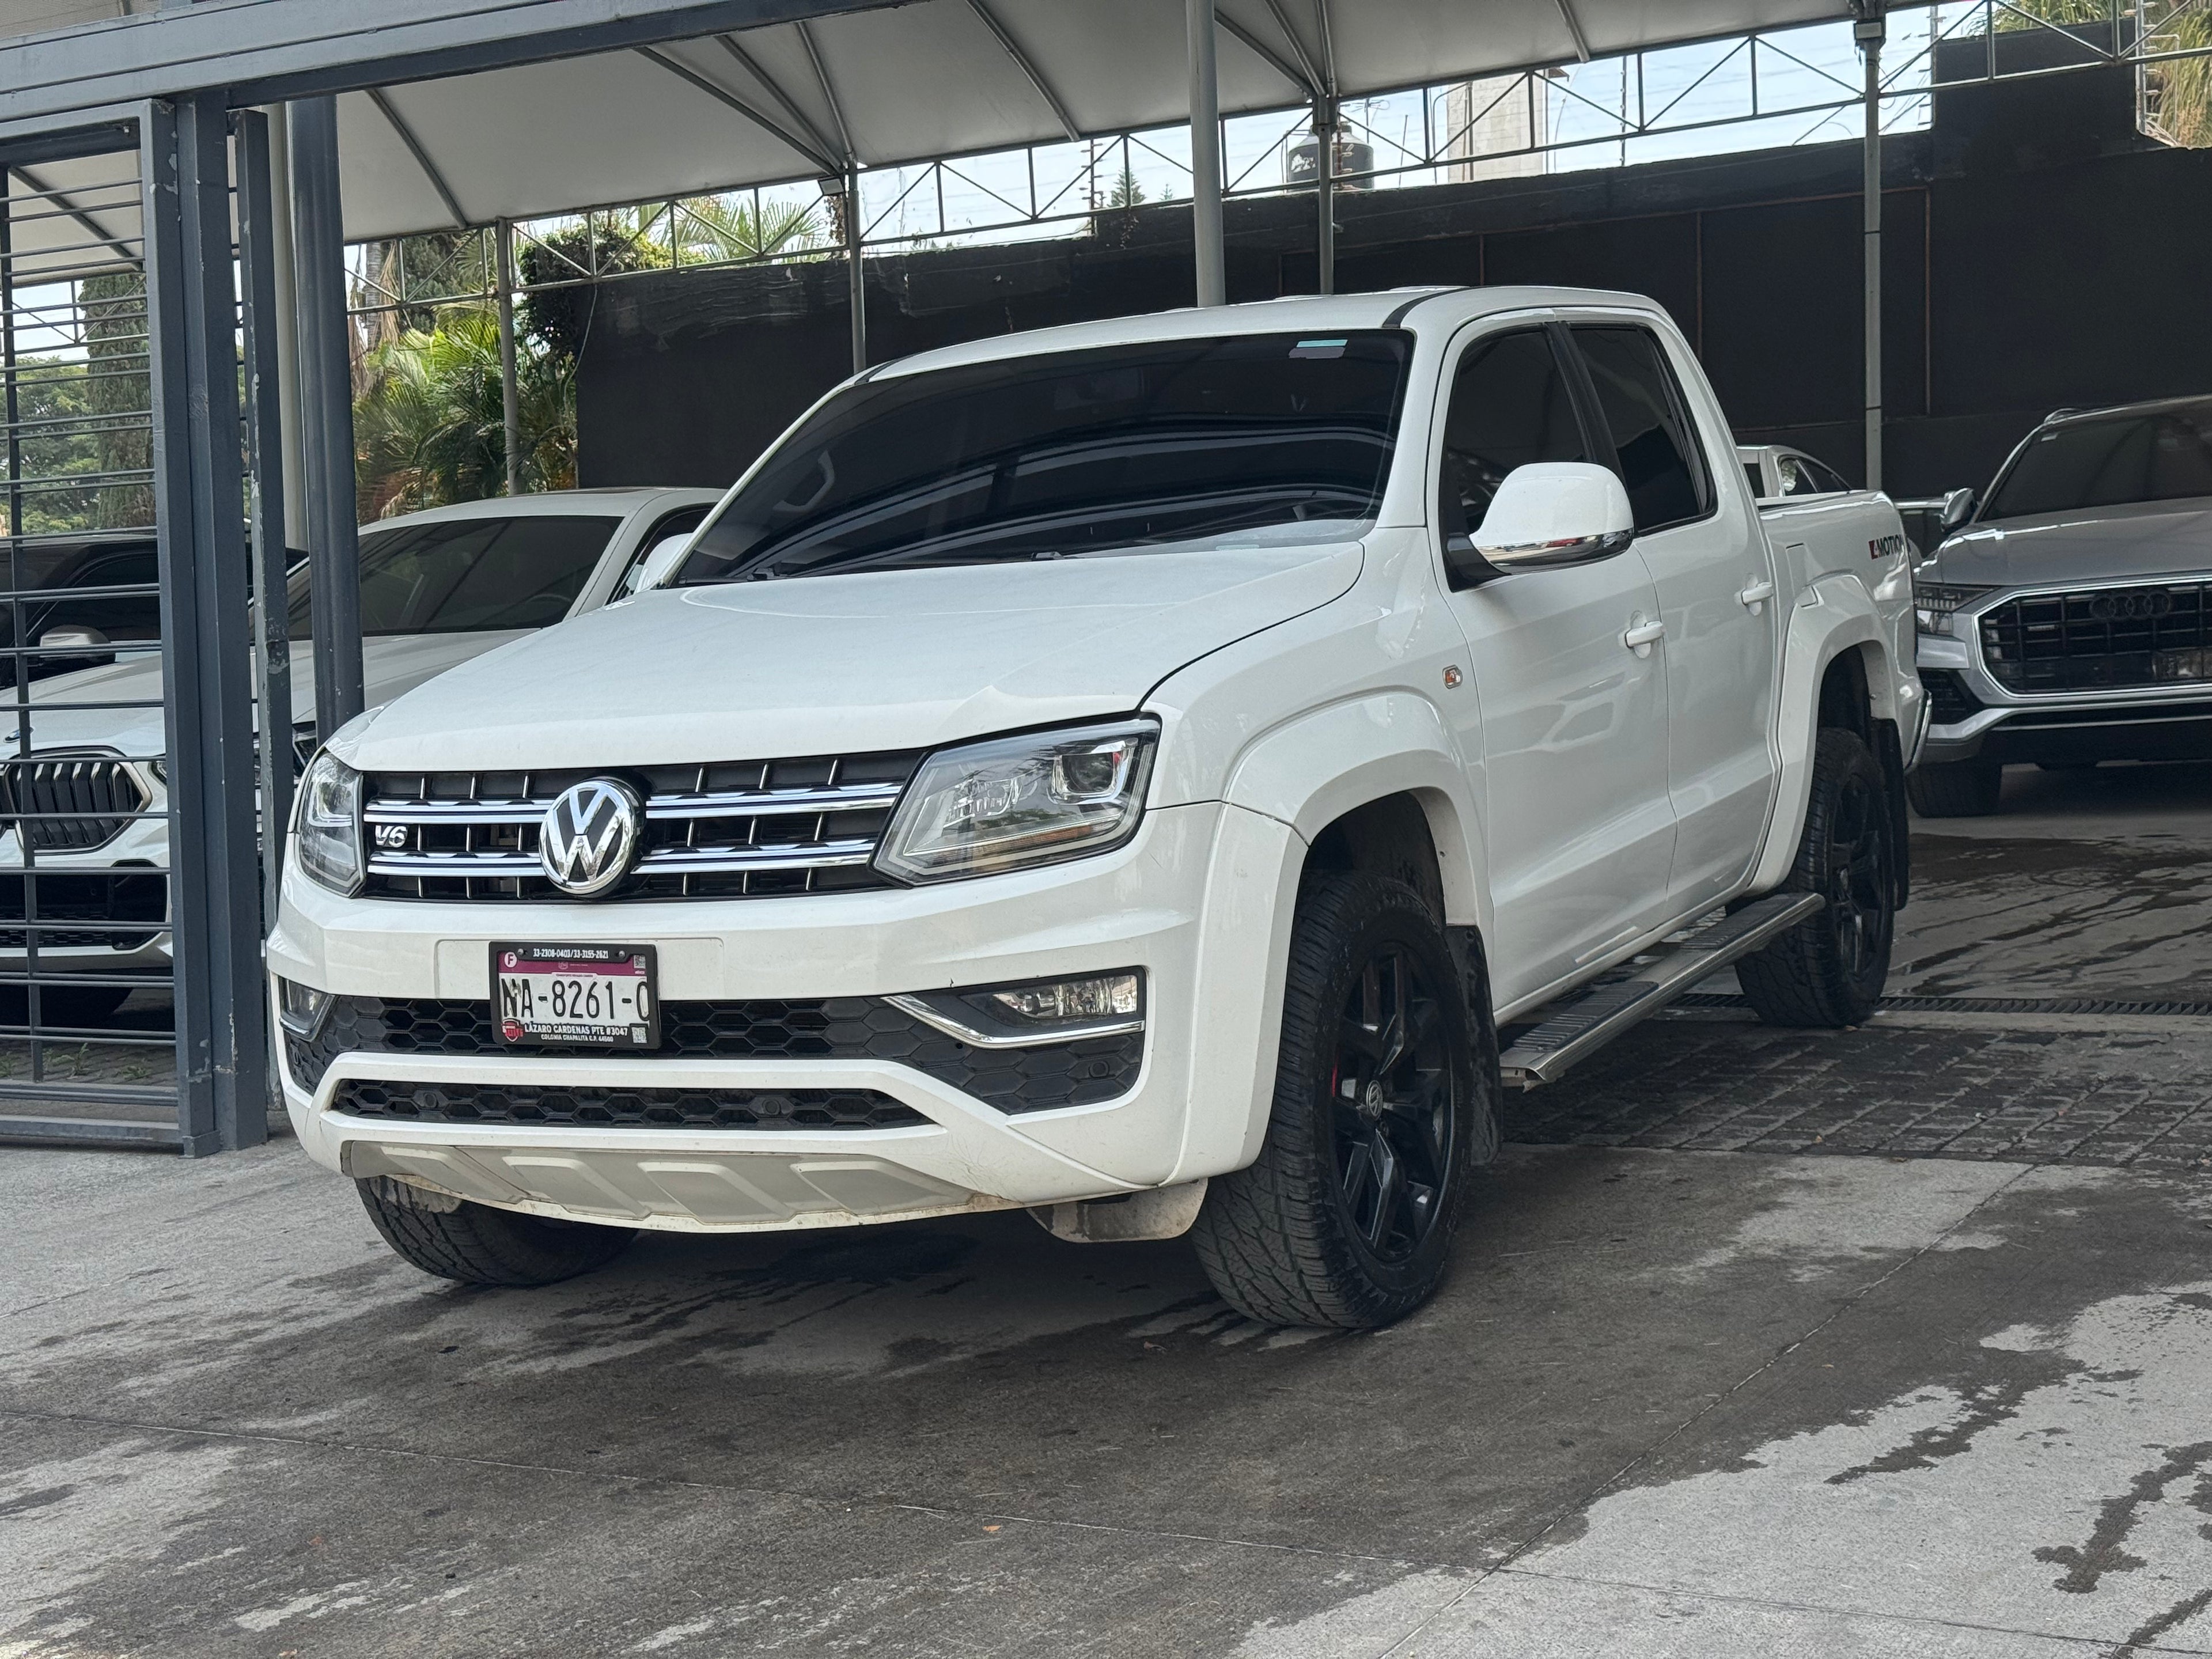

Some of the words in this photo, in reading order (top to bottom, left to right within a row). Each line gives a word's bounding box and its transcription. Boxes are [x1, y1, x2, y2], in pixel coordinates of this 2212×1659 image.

[375, 825, 407, 847] V6
[507, 954, 514, 965] F
[591, 1026, 605, 1035] PTE
